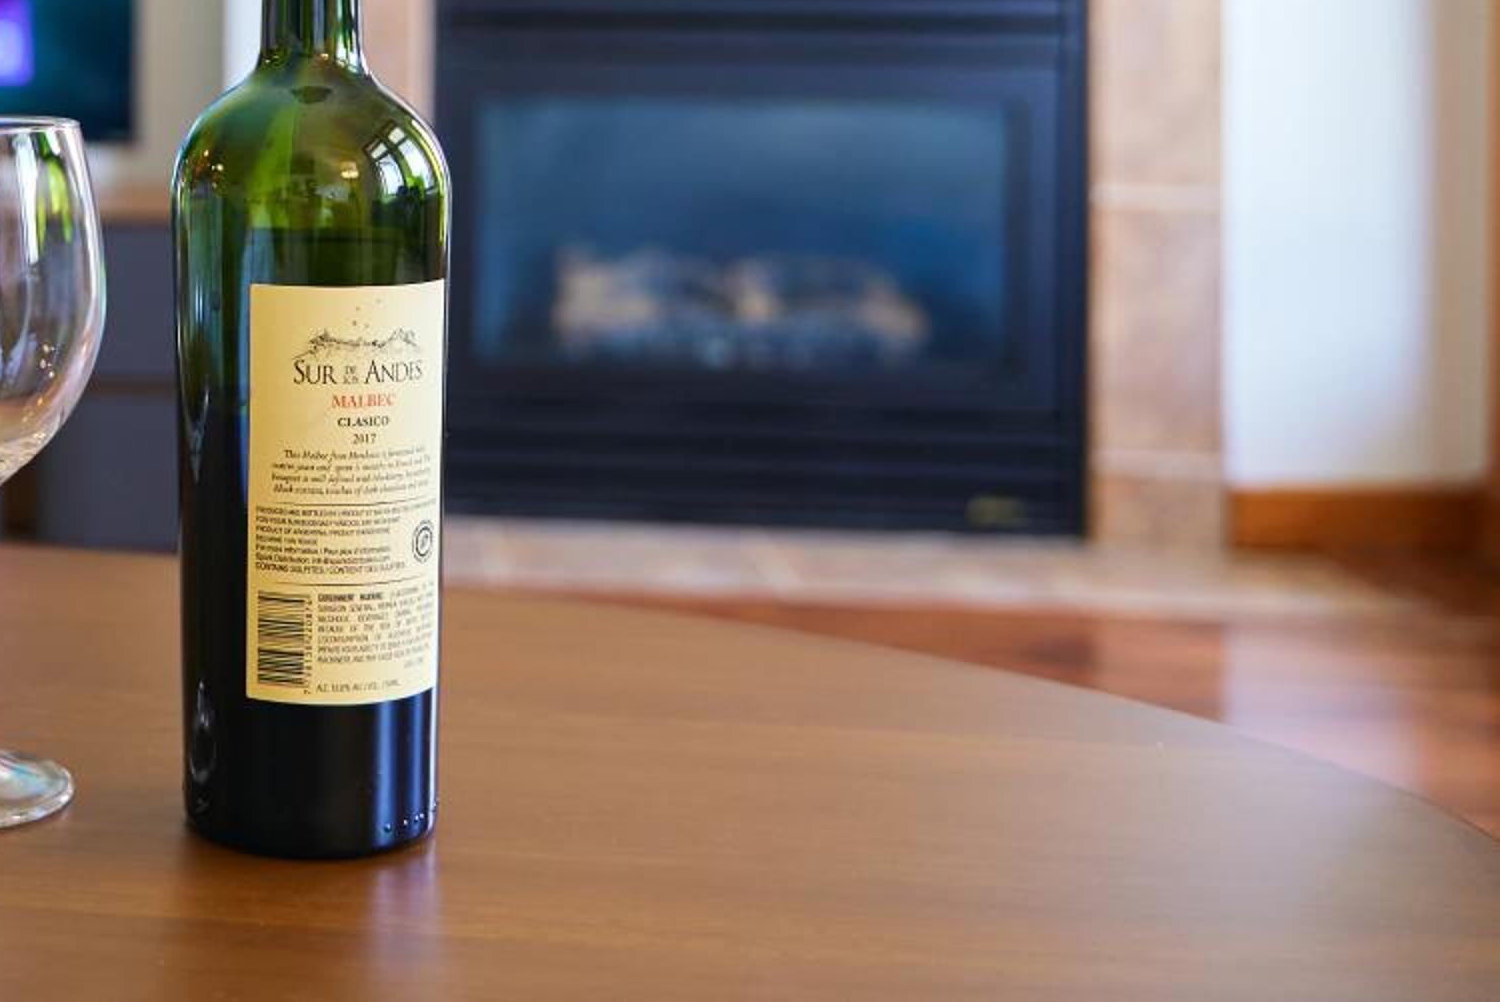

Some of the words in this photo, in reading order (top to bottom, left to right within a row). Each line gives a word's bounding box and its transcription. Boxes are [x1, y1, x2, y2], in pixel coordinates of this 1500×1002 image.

[293, 359, 337, 385] SUR
[364, 359, 423, 385] ANDES
[331, 395, 395, 408] MALBEC
[337, 416, 389, 427] CLASICO
[352, 433, 377, 444] 2017
